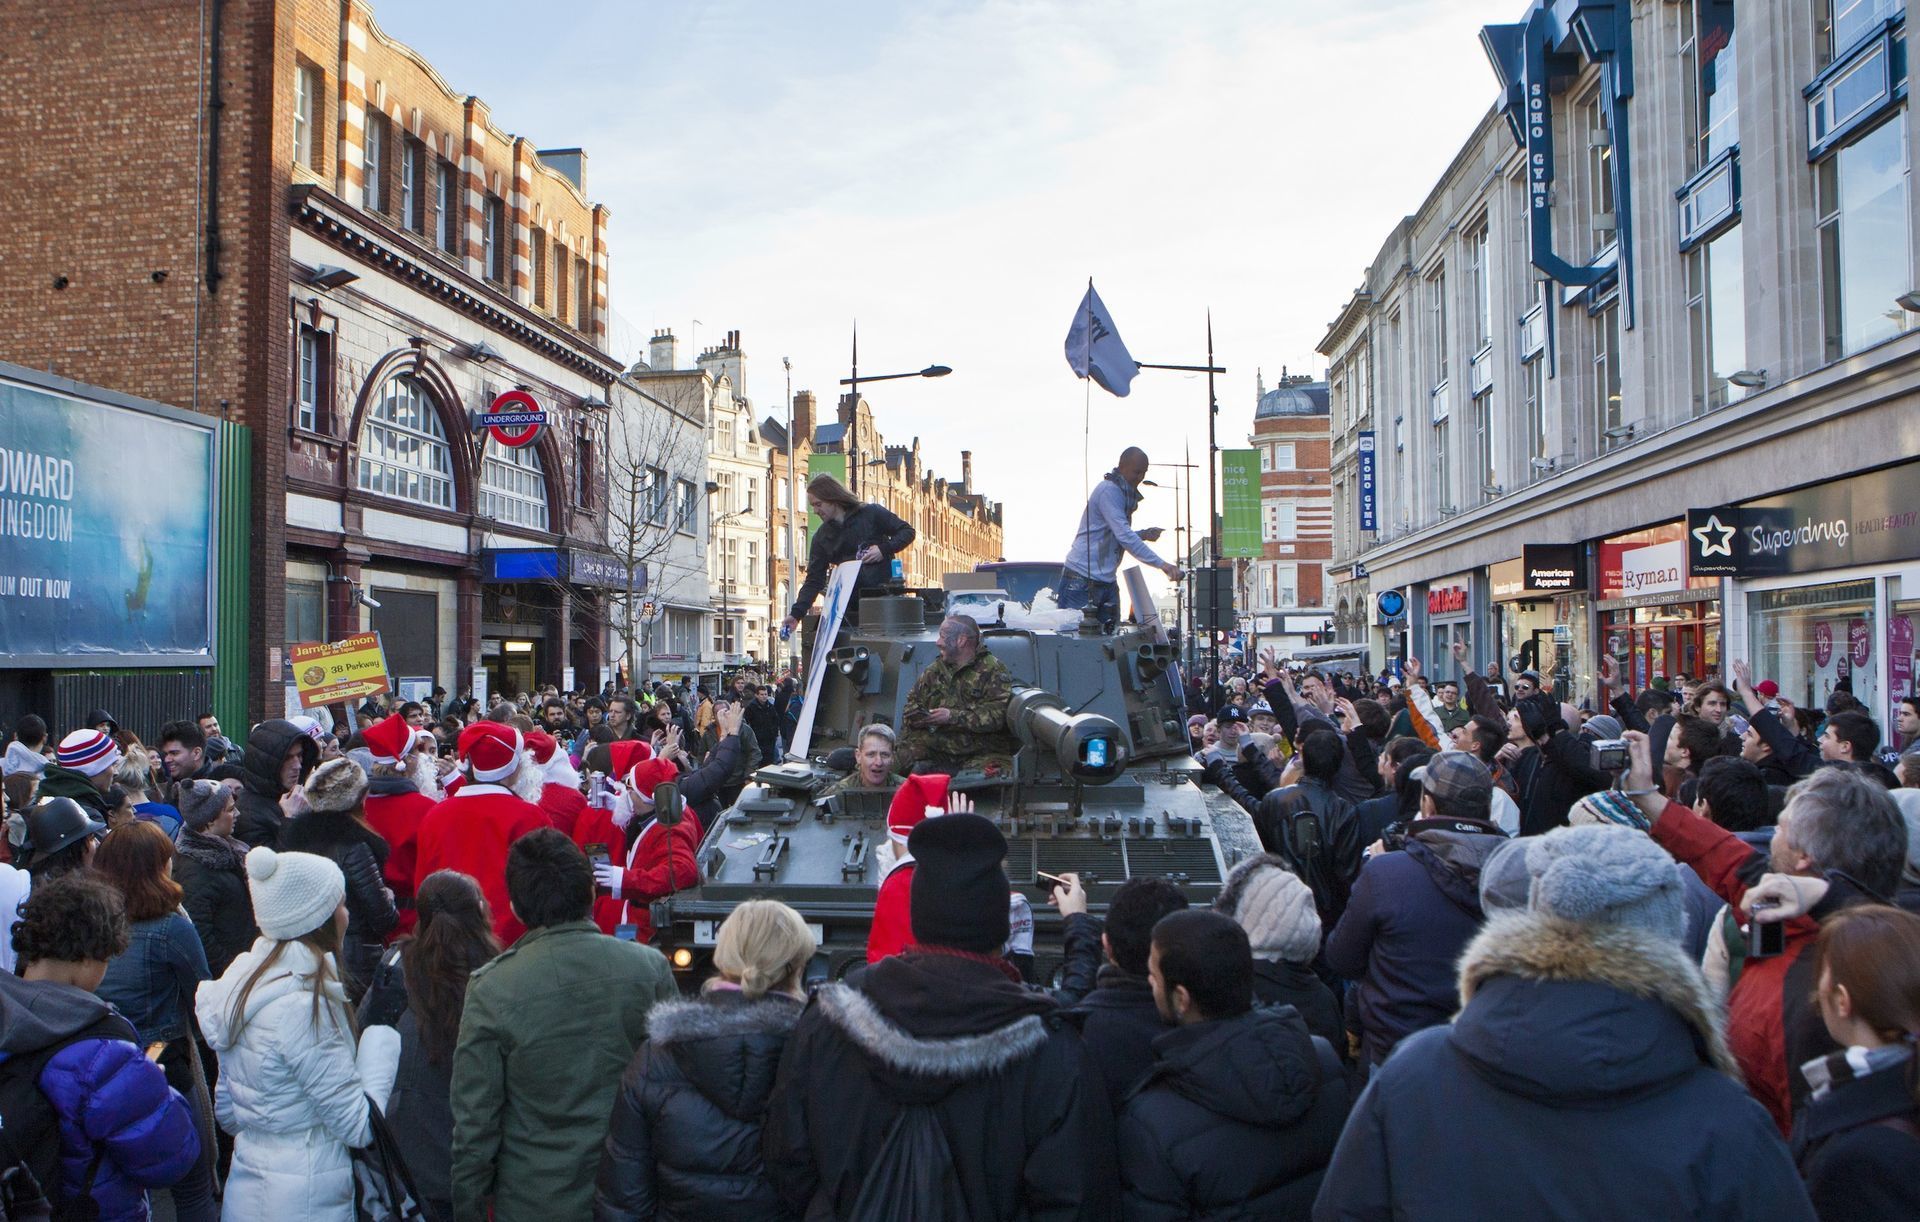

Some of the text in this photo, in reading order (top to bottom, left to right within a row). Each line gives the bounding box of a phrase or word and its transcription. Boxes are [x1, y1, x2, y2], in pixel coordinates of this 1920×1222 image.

[1531, 84, 1546, 208] SOHO GYMS
[484, 414, 544, 424] UNDERGROUND
[1223, 464, 1246, 474] nice
[1223, 477, 1249, 486] save
[1363, 457, 1373, 527] SOHO GYMS
[1751, 517, 1850, 556] Superdrug
[1531, 569, 1574, 578] American
[1693, 565, 1737, 573] Superdrug
[1535, 578, 1571, 588] Apparel
[1625, 567, 1679, 590] Ryman
[19, 576, 43, 598] OUT
[45, 579, 72, 600] NOW
[1625, 597, 1639, 607] the
[1640, 593, 1680, 606] stationer
[340, 636, 375, 648] amon
[330, 660, 380, 674] 38 Parkway
